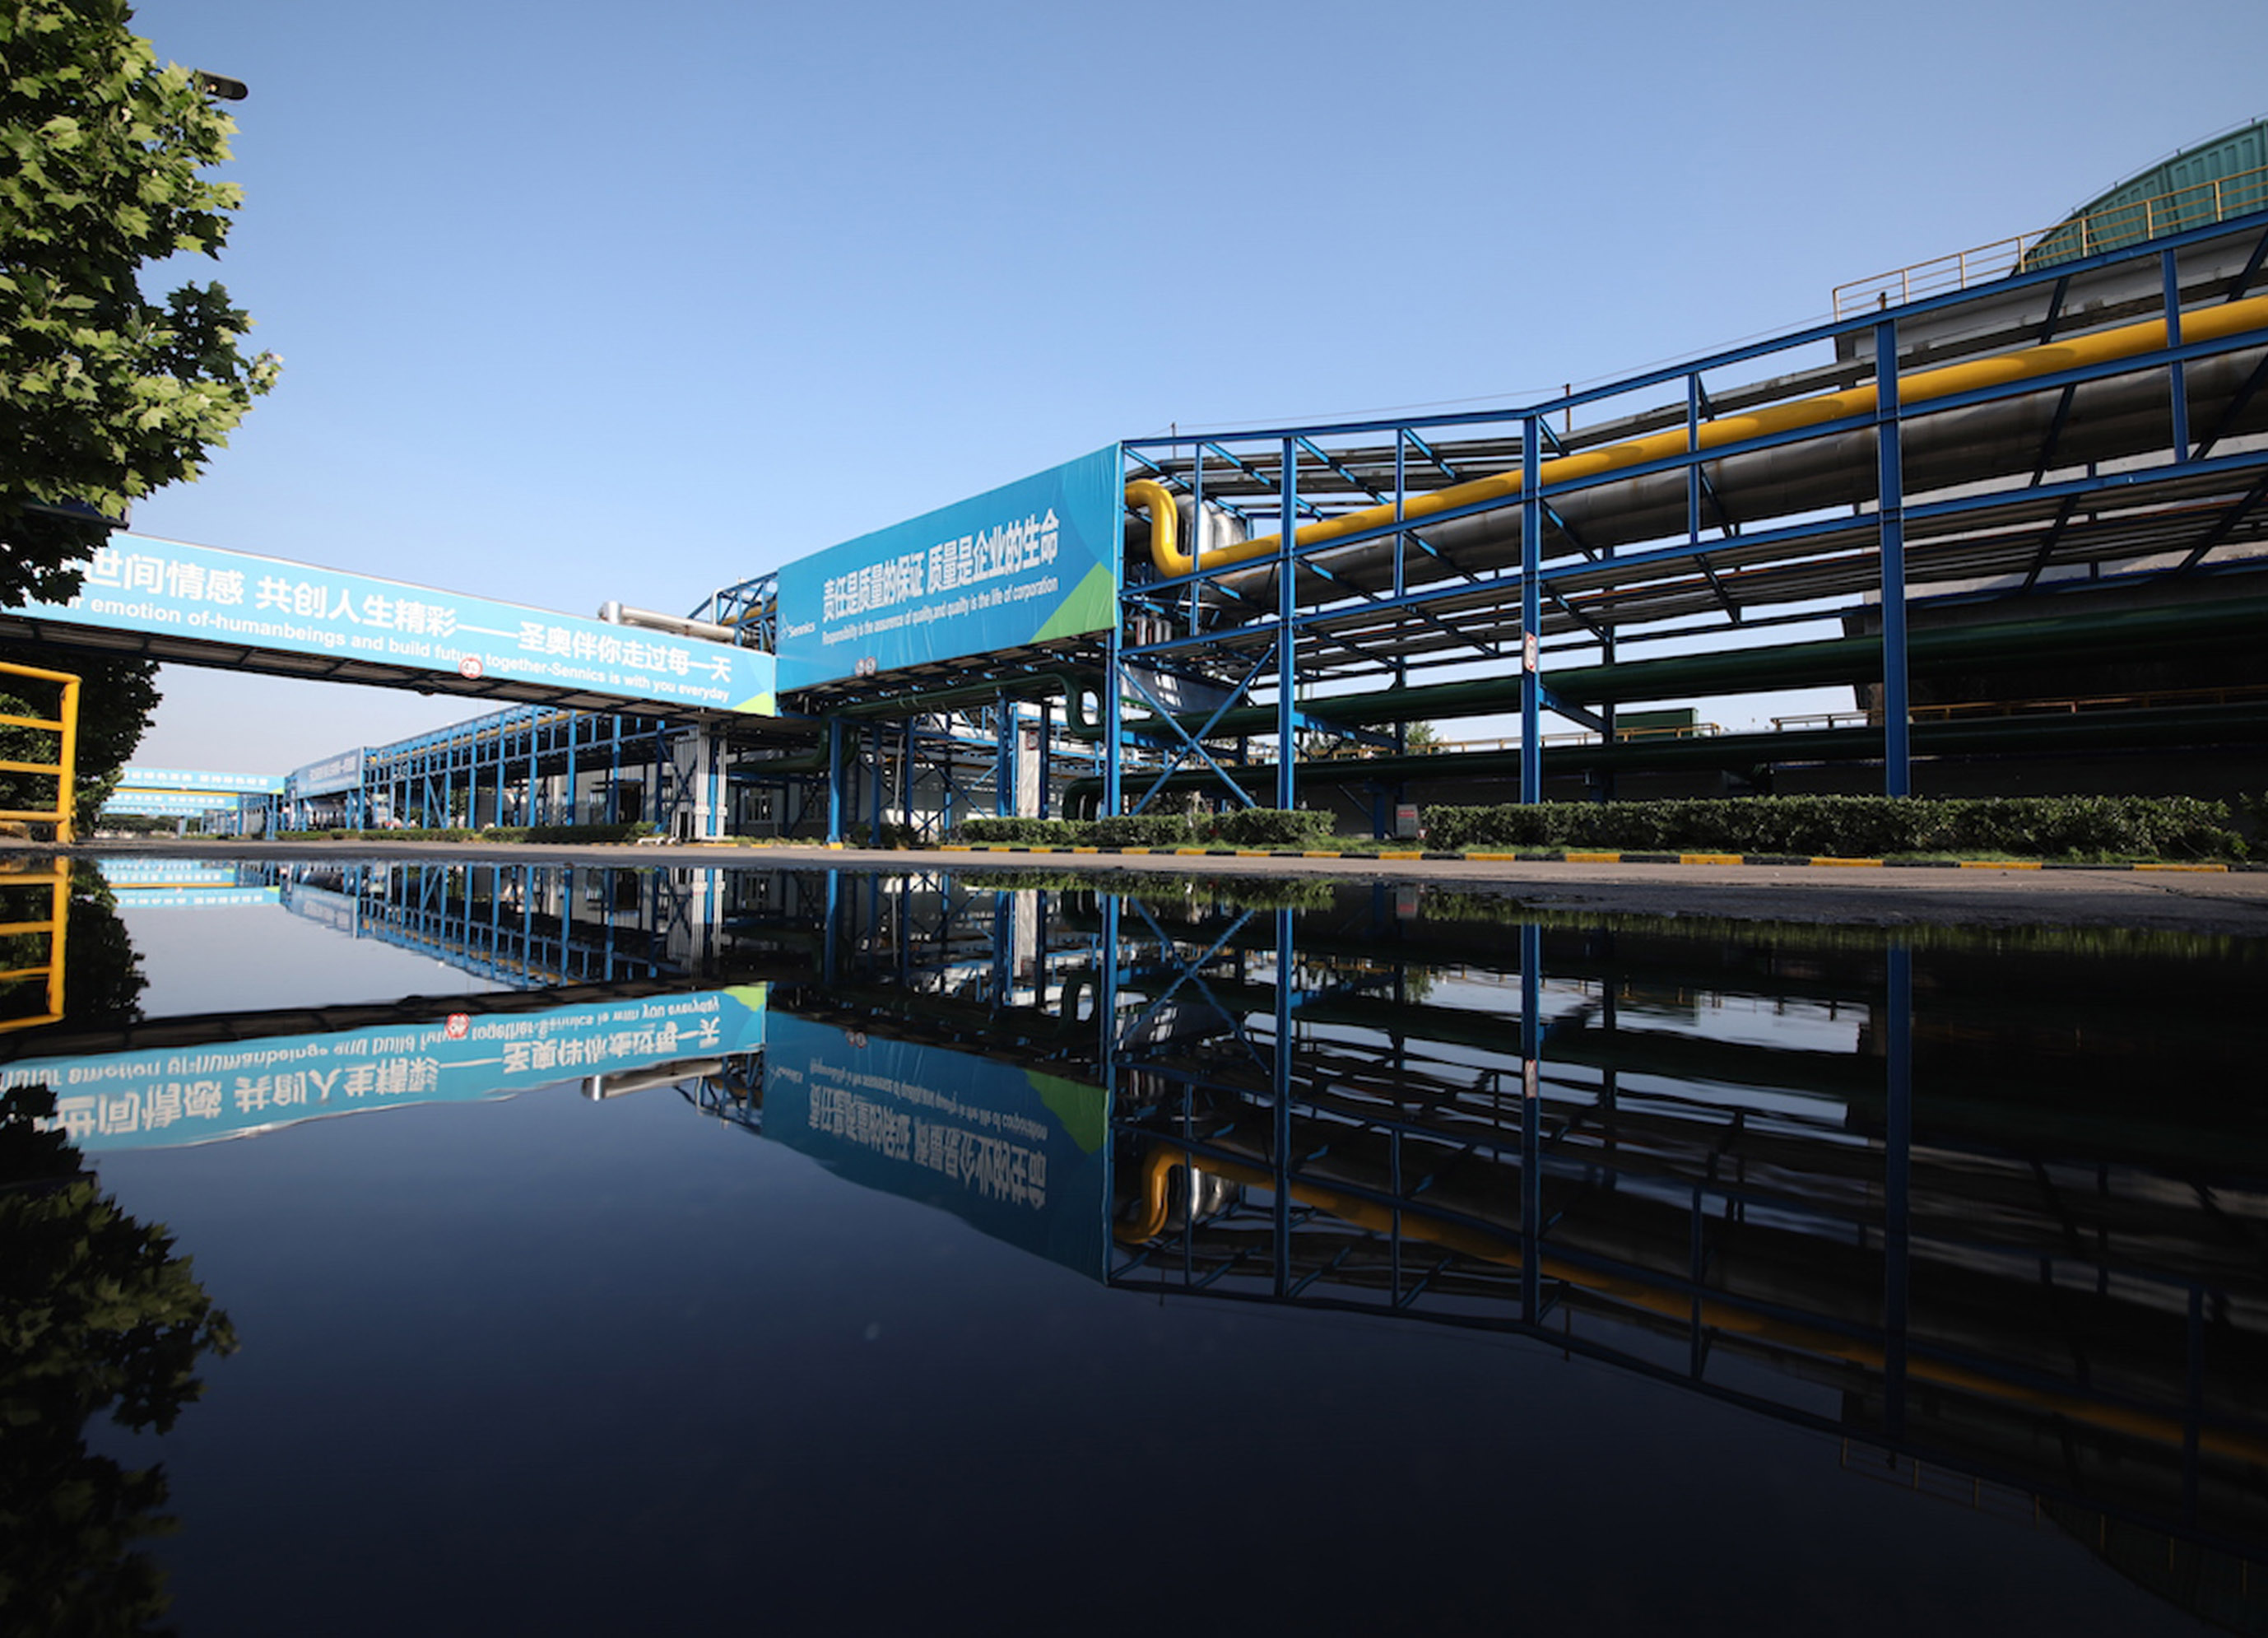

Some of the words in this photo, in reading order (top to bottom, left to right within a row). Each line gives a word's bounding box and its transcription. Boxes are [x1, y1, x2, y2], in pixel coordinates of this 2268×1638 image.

[62, 548, 245, 606] 世间情感
[926, 508, 1060, 595] 质量是企业的生命
[1012, 575, 1059, 603] corporation
[91, 598, 180, 624] emotion
[351, 634, 385, 653] and
[388, 639, 430, 658] build
[609, 668, 620, 686] is
[623, 671, 651, 690] with
[653, 677, 676, 696] you
[678, 680, 730, 703] everyday
